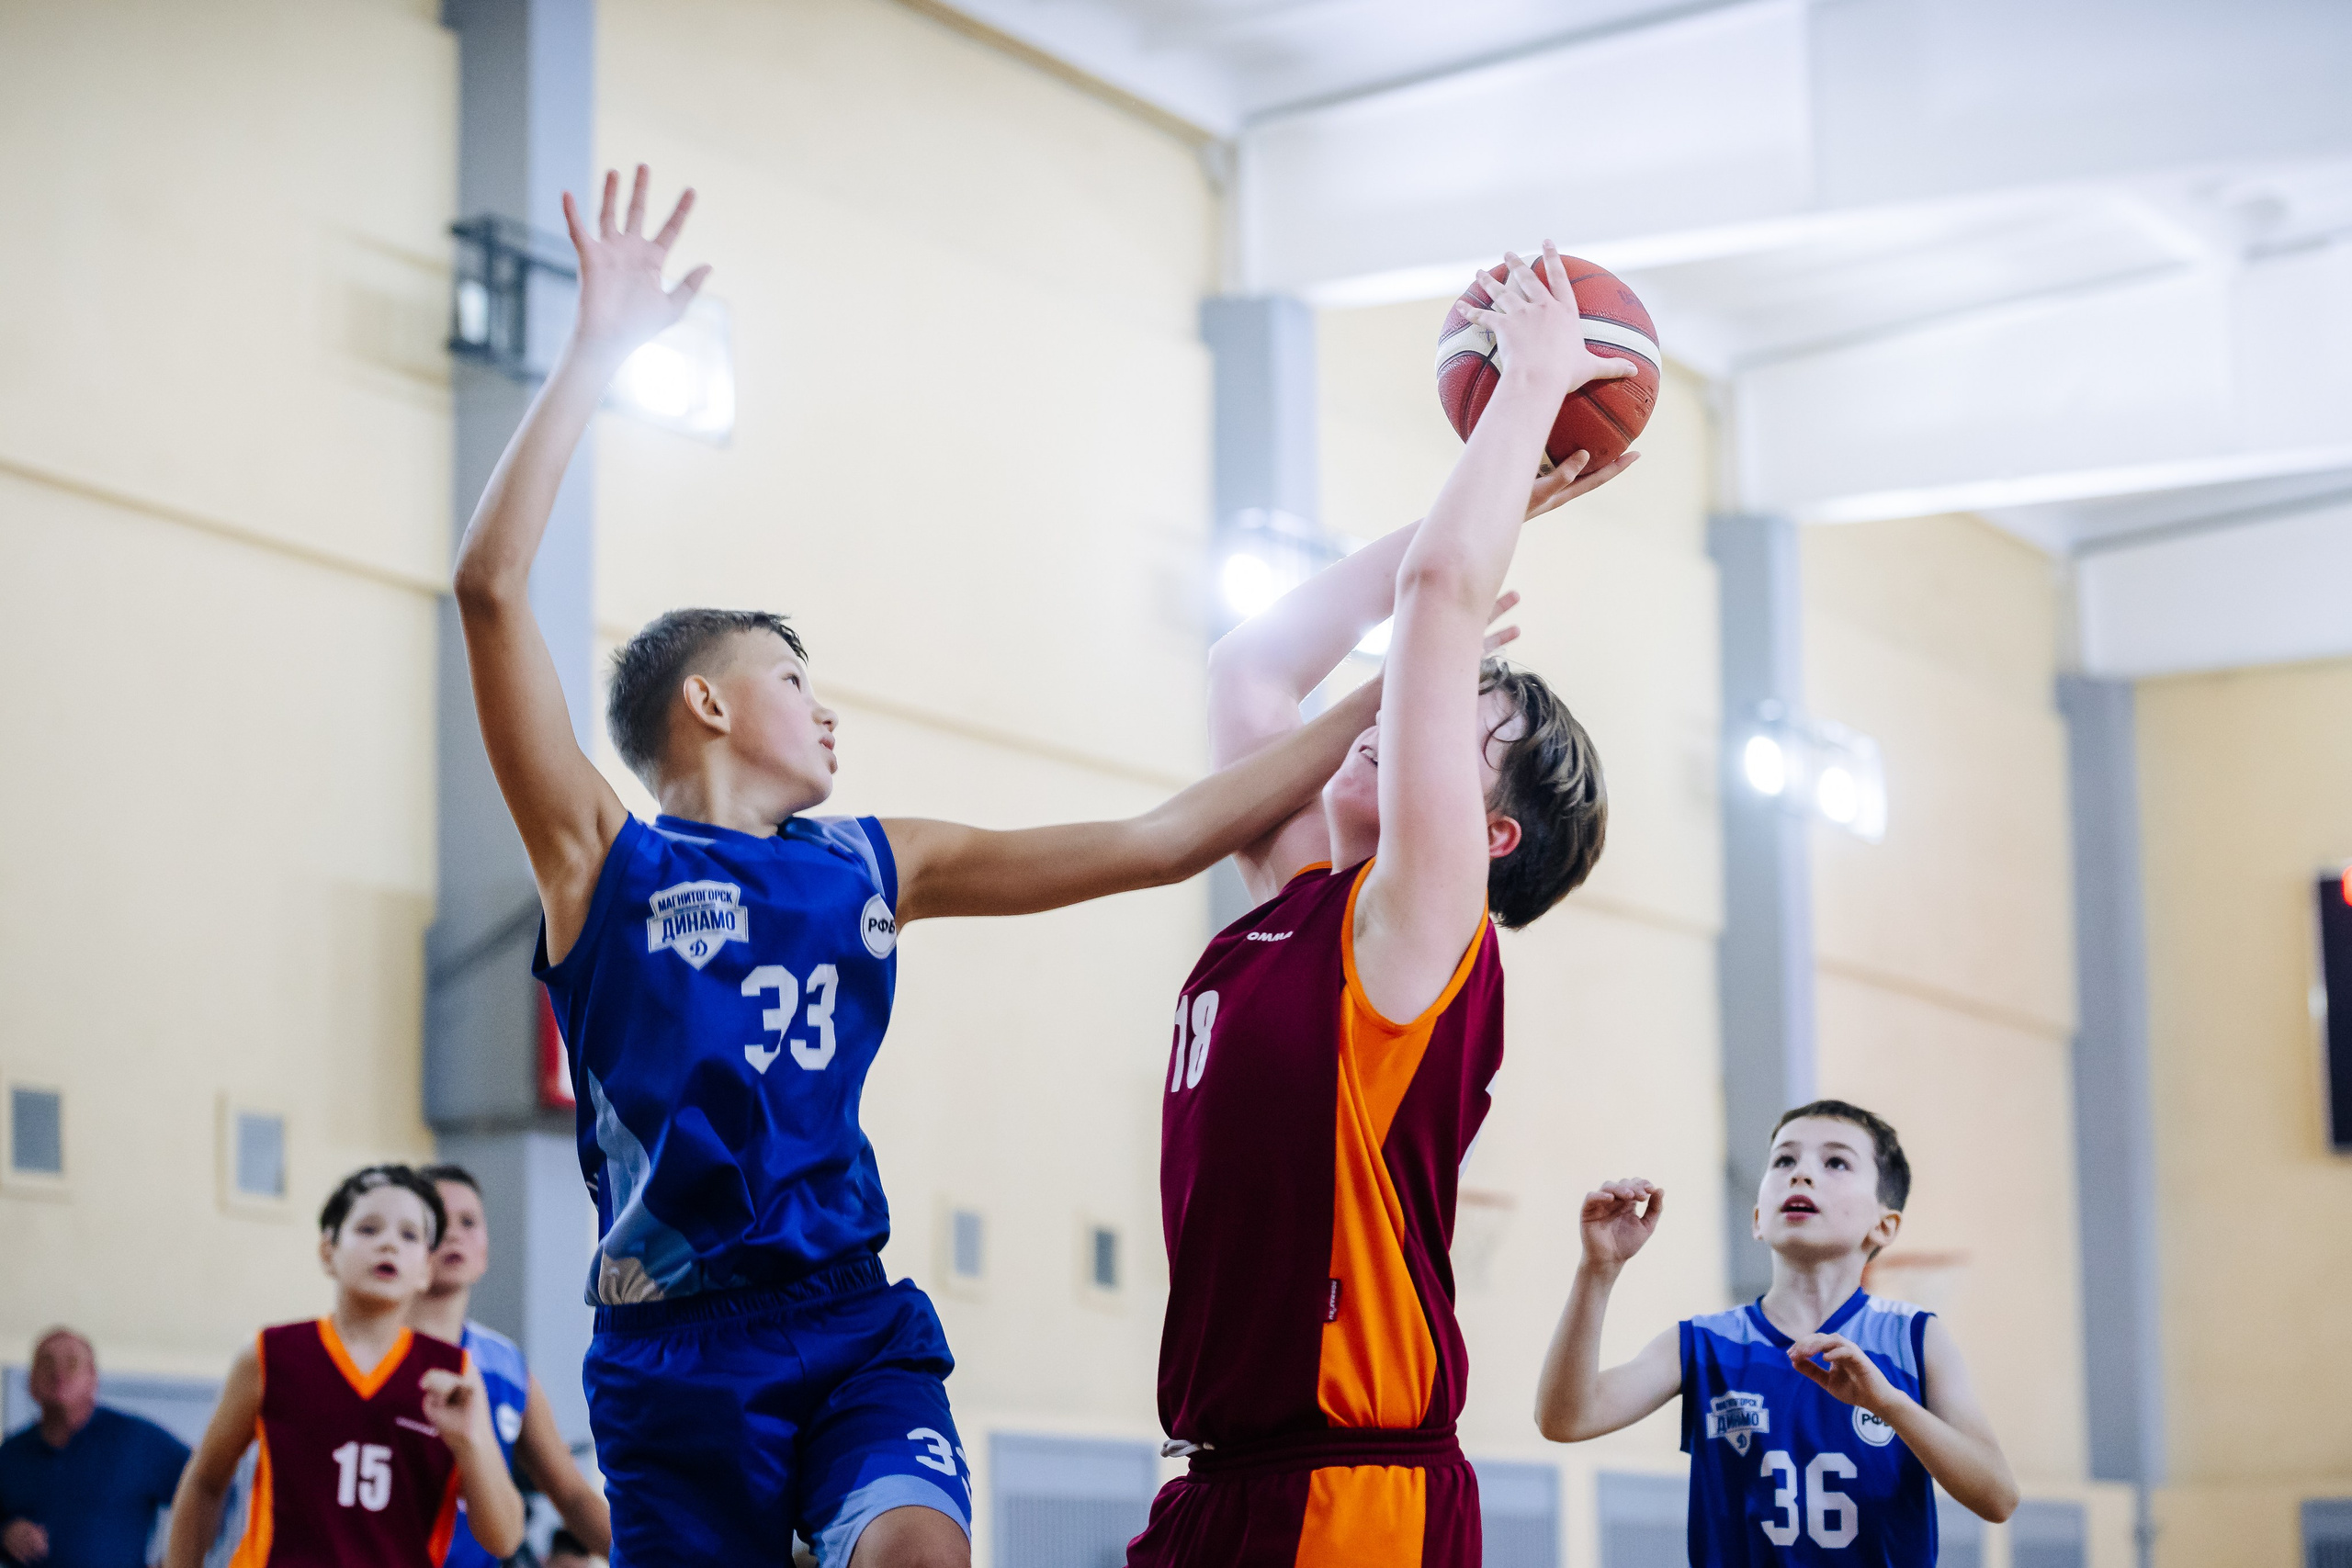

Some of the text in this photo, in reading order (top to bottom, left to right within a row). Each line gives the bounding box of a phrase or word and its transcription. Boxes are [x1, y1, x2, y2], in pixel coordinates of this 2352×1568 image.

[657, 887, 733, 912] МАГНИТОГОРСК
[662, 909, 736, 943] ДИНАМО
[741, 964, 840, 1075] 33
[1170, 989, 1220, 1093] 18
[332, 1440, 393, 1512] 15
[1759, 1450, 1860, 1550] 36
